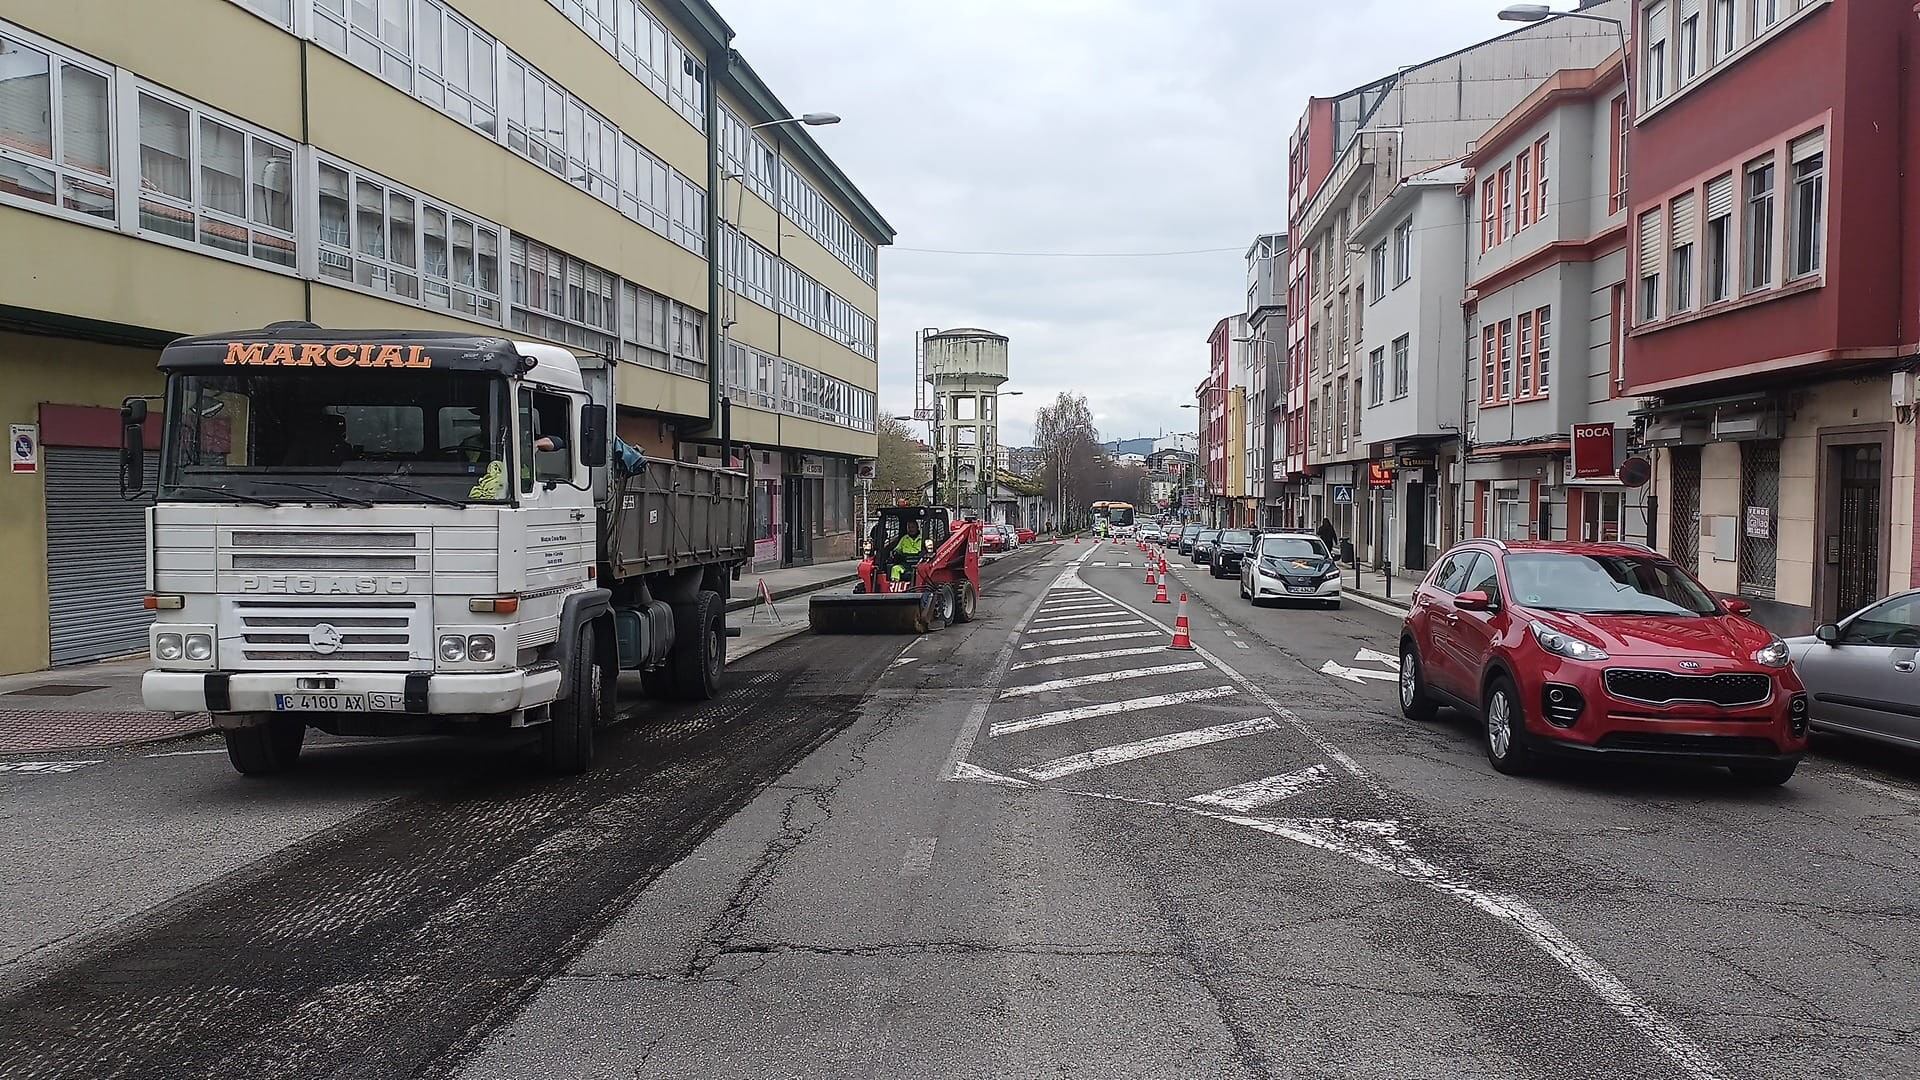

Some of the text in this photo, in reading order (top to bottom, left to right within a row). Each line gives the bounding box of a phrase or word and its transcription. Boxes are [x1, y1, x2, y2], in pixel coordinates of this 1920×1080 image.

[223, 342, 432, 369] MARCIAL
[1576, 427, 1611, 438] ROCA
[240, 576, 409, 594] PEGASO
[284, 695, 363, 711] C 4100 AX
